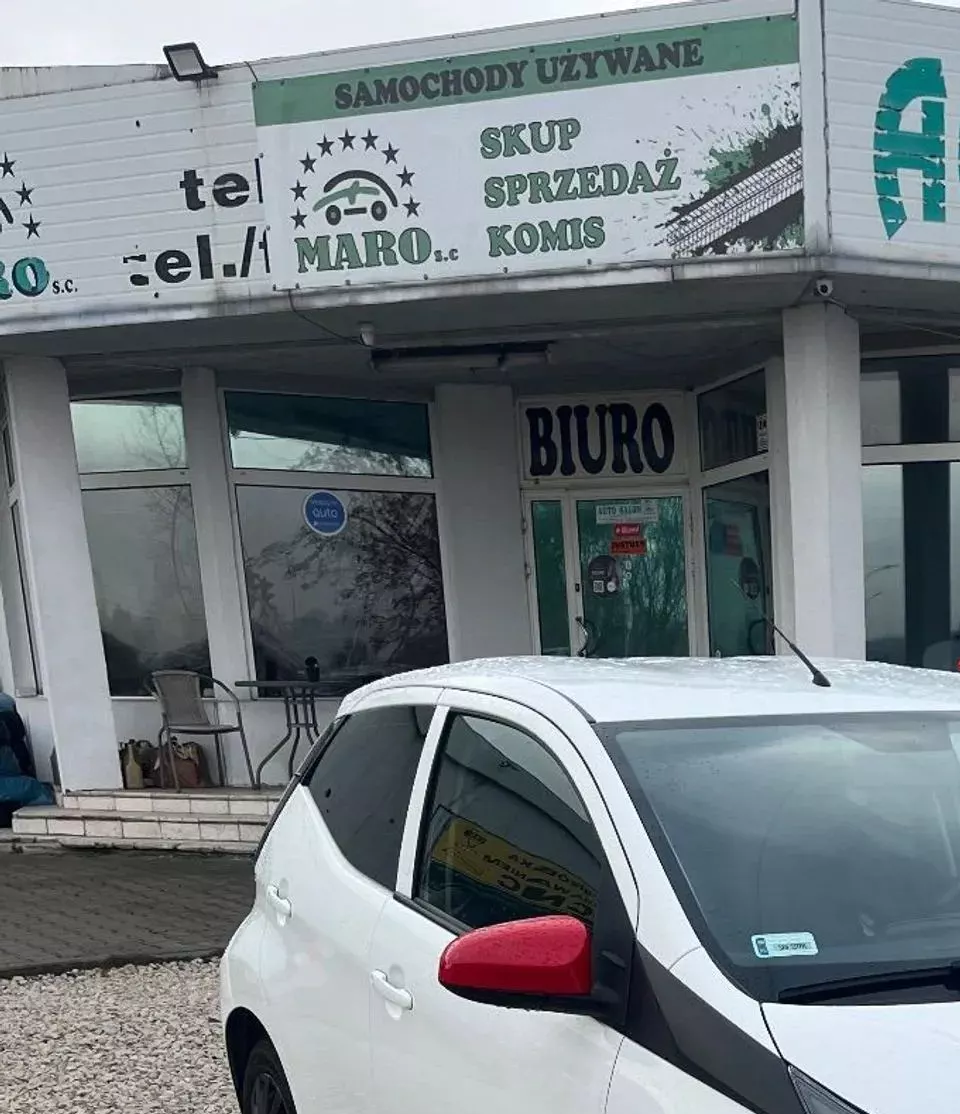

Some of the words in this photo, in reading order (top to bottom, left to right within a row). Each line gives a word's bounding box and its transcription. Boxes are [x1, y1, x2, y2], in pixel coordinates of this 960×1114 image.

[334, 60, 529, 111] SAMOCHODY
[480, 117, 581, 160] SKUP
[484, 157, 682, 209] SPRZEDAŻ
[294, 227, 432, 274] MARO
[487, 216, 606, 259] KOMIS
[52, 279, 79, 295] s.c.
[525, 402, 676, 477] BIURO
